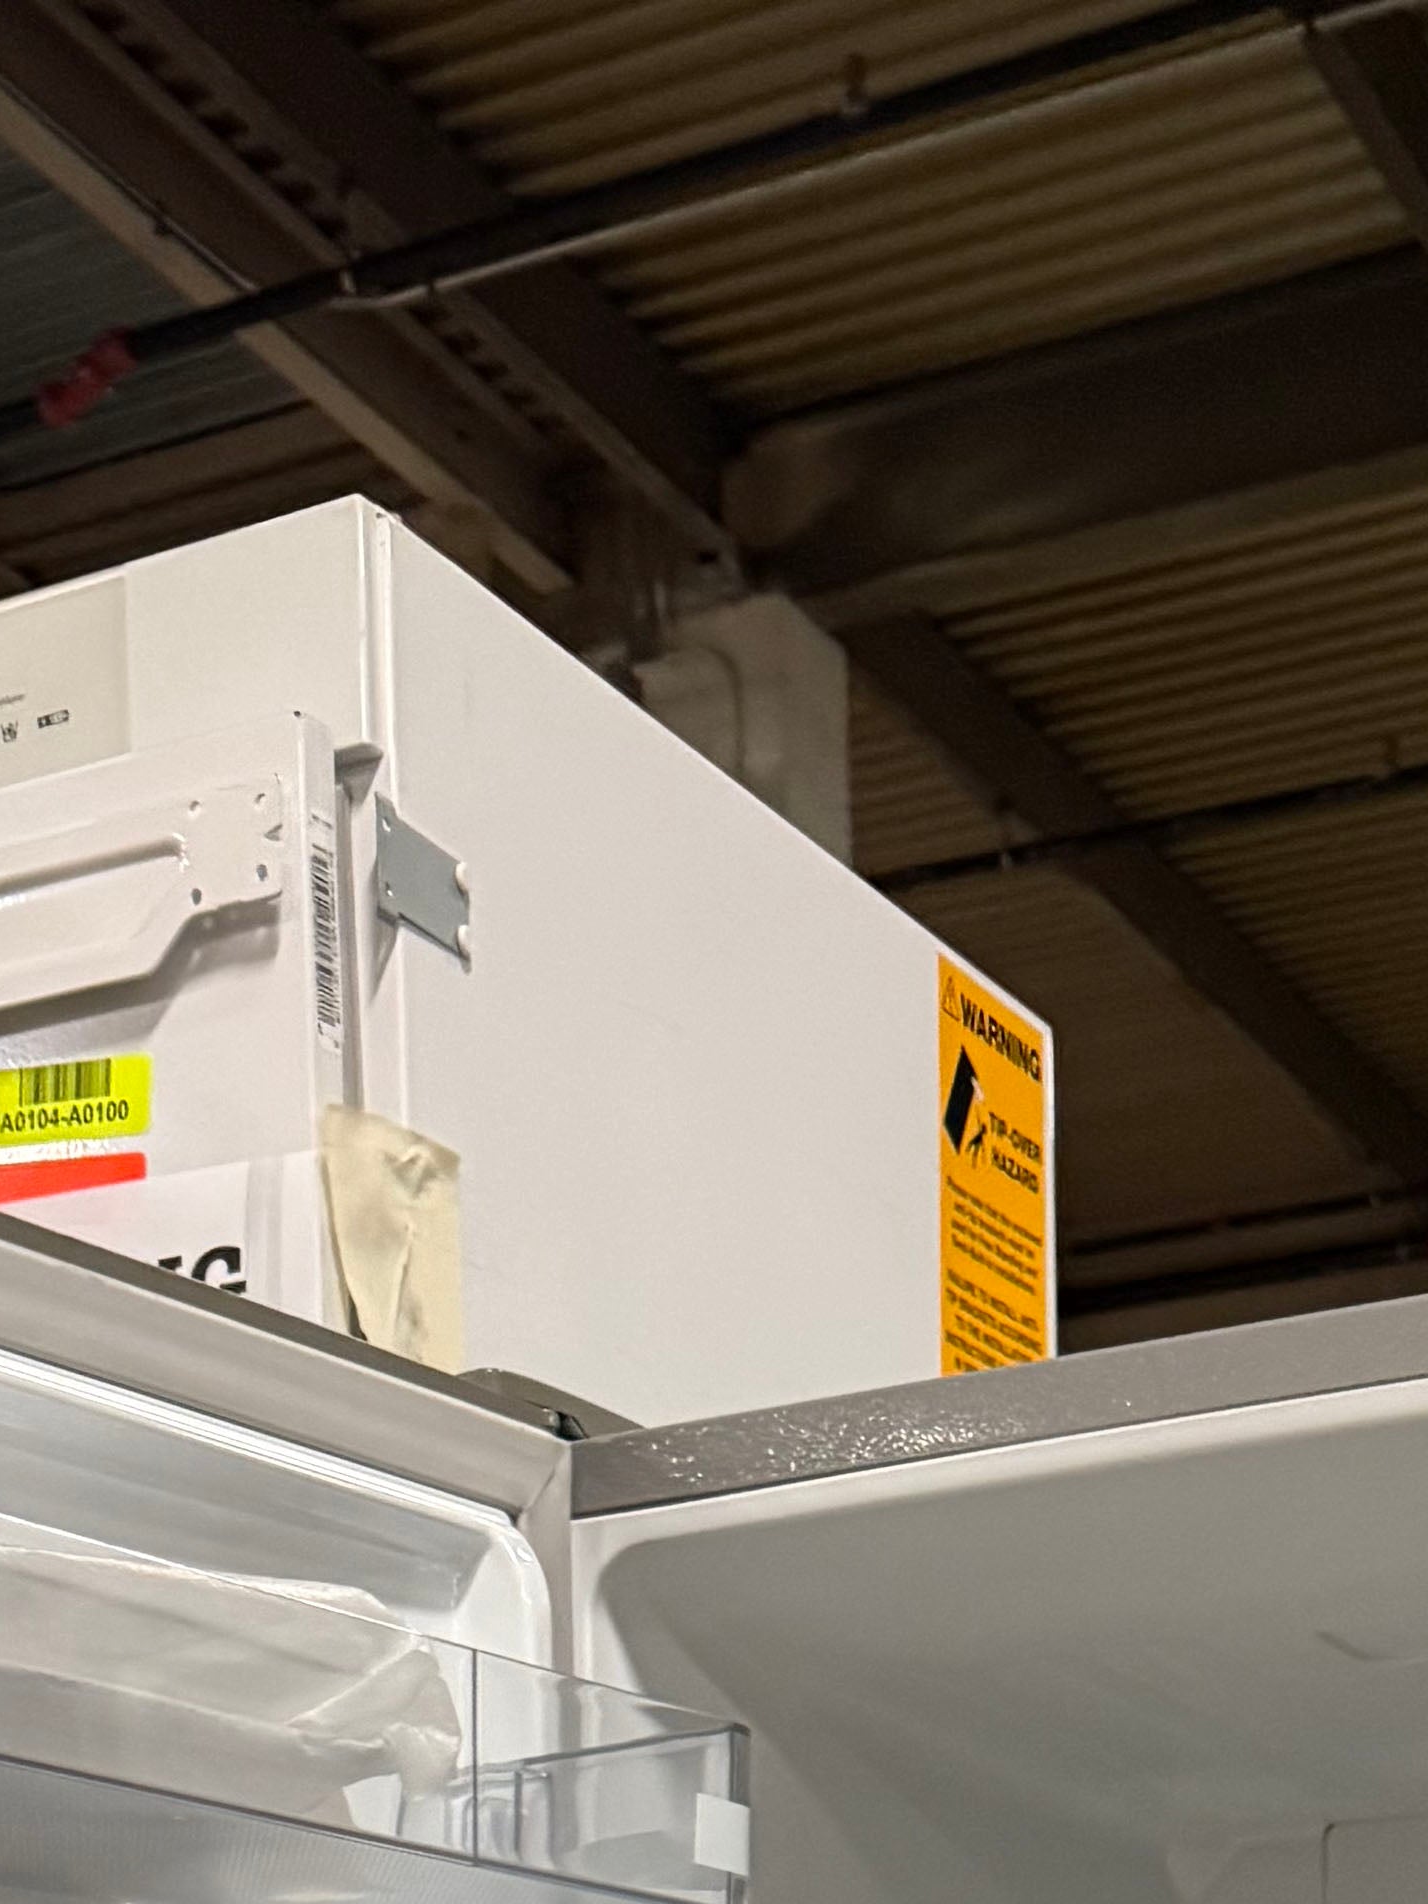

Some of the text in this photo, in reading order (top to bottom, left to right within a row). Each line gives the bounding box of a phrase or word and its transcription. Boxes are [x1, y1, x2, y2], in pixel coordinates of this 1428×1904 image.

[960, 992, 1041, 1084] WARNING
[0, 1099, 130, 1134] A0104-A0100
[988, 1111, 1041, 1161] TIP-OVER
[991, 1147, 1040, 1194] HAZARD
